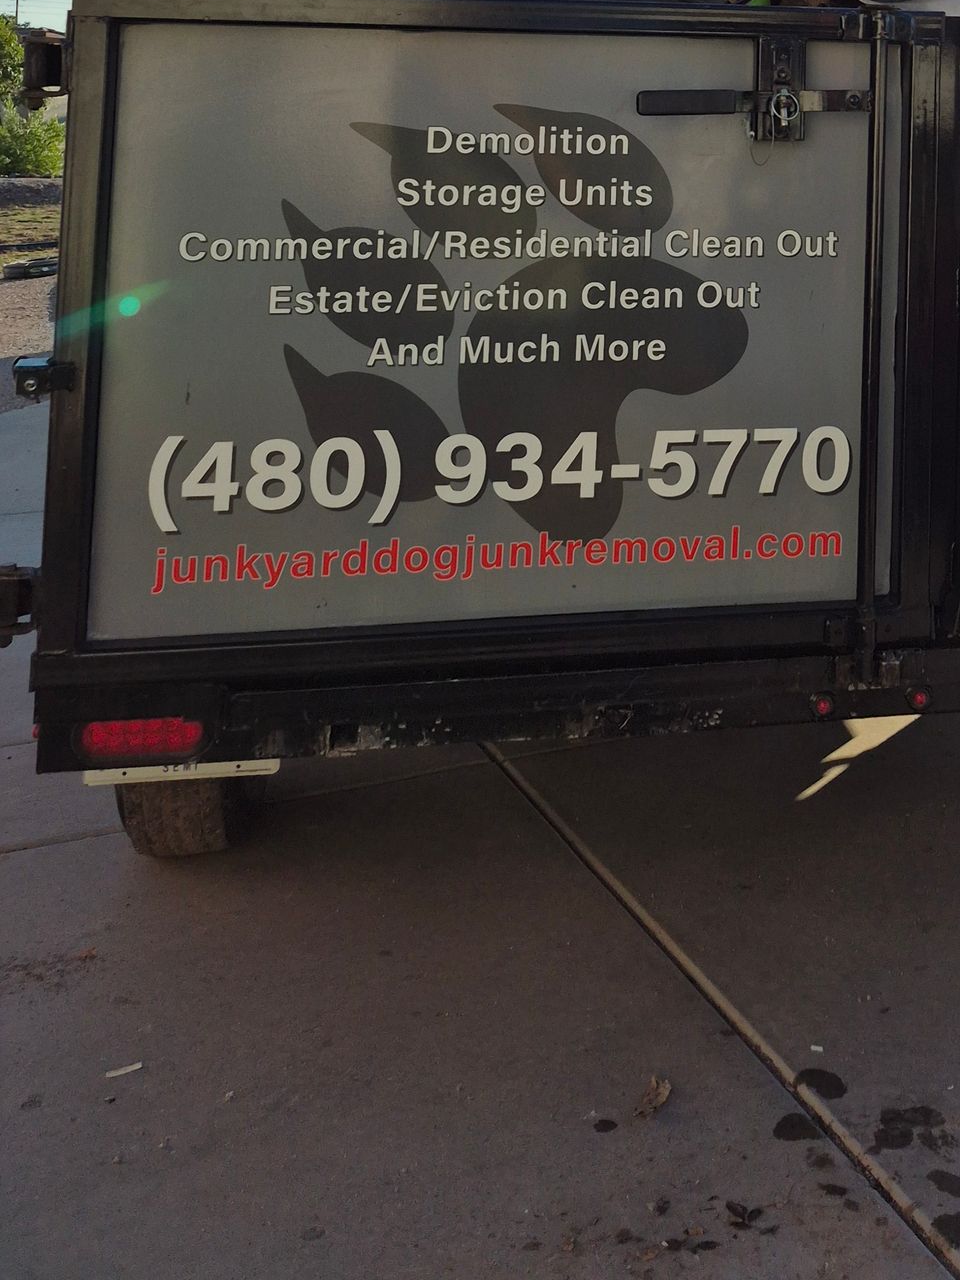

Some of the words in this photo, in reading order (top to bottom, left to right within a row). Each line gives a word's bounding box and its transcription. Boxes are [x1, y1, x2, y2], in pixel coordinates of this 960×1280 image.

[426, 126, 630, 155] Demolition
[397, 178, 546, 214] Storage
[559, 177, 654, 206] Units
[178, 228, 652, 262] Commercial/Residential
[664, 229, 765, 258] Clean
[776, 229, 839, 257] Out
[268, 281, 568, 314] Estate/Eviction
[580, 280, 684, 310] Clean
[696, 281, 761, 309] Out
[367, 335, 445, 367] And
[459, 333, 560, 365] Much
[575, 333, 667, 363] More
[148, 429, 402, 533] (480)
[433, 425, 852, 505] 934-5770
[151, 525, 844, 595] junkyarddogjunkremoval.com
